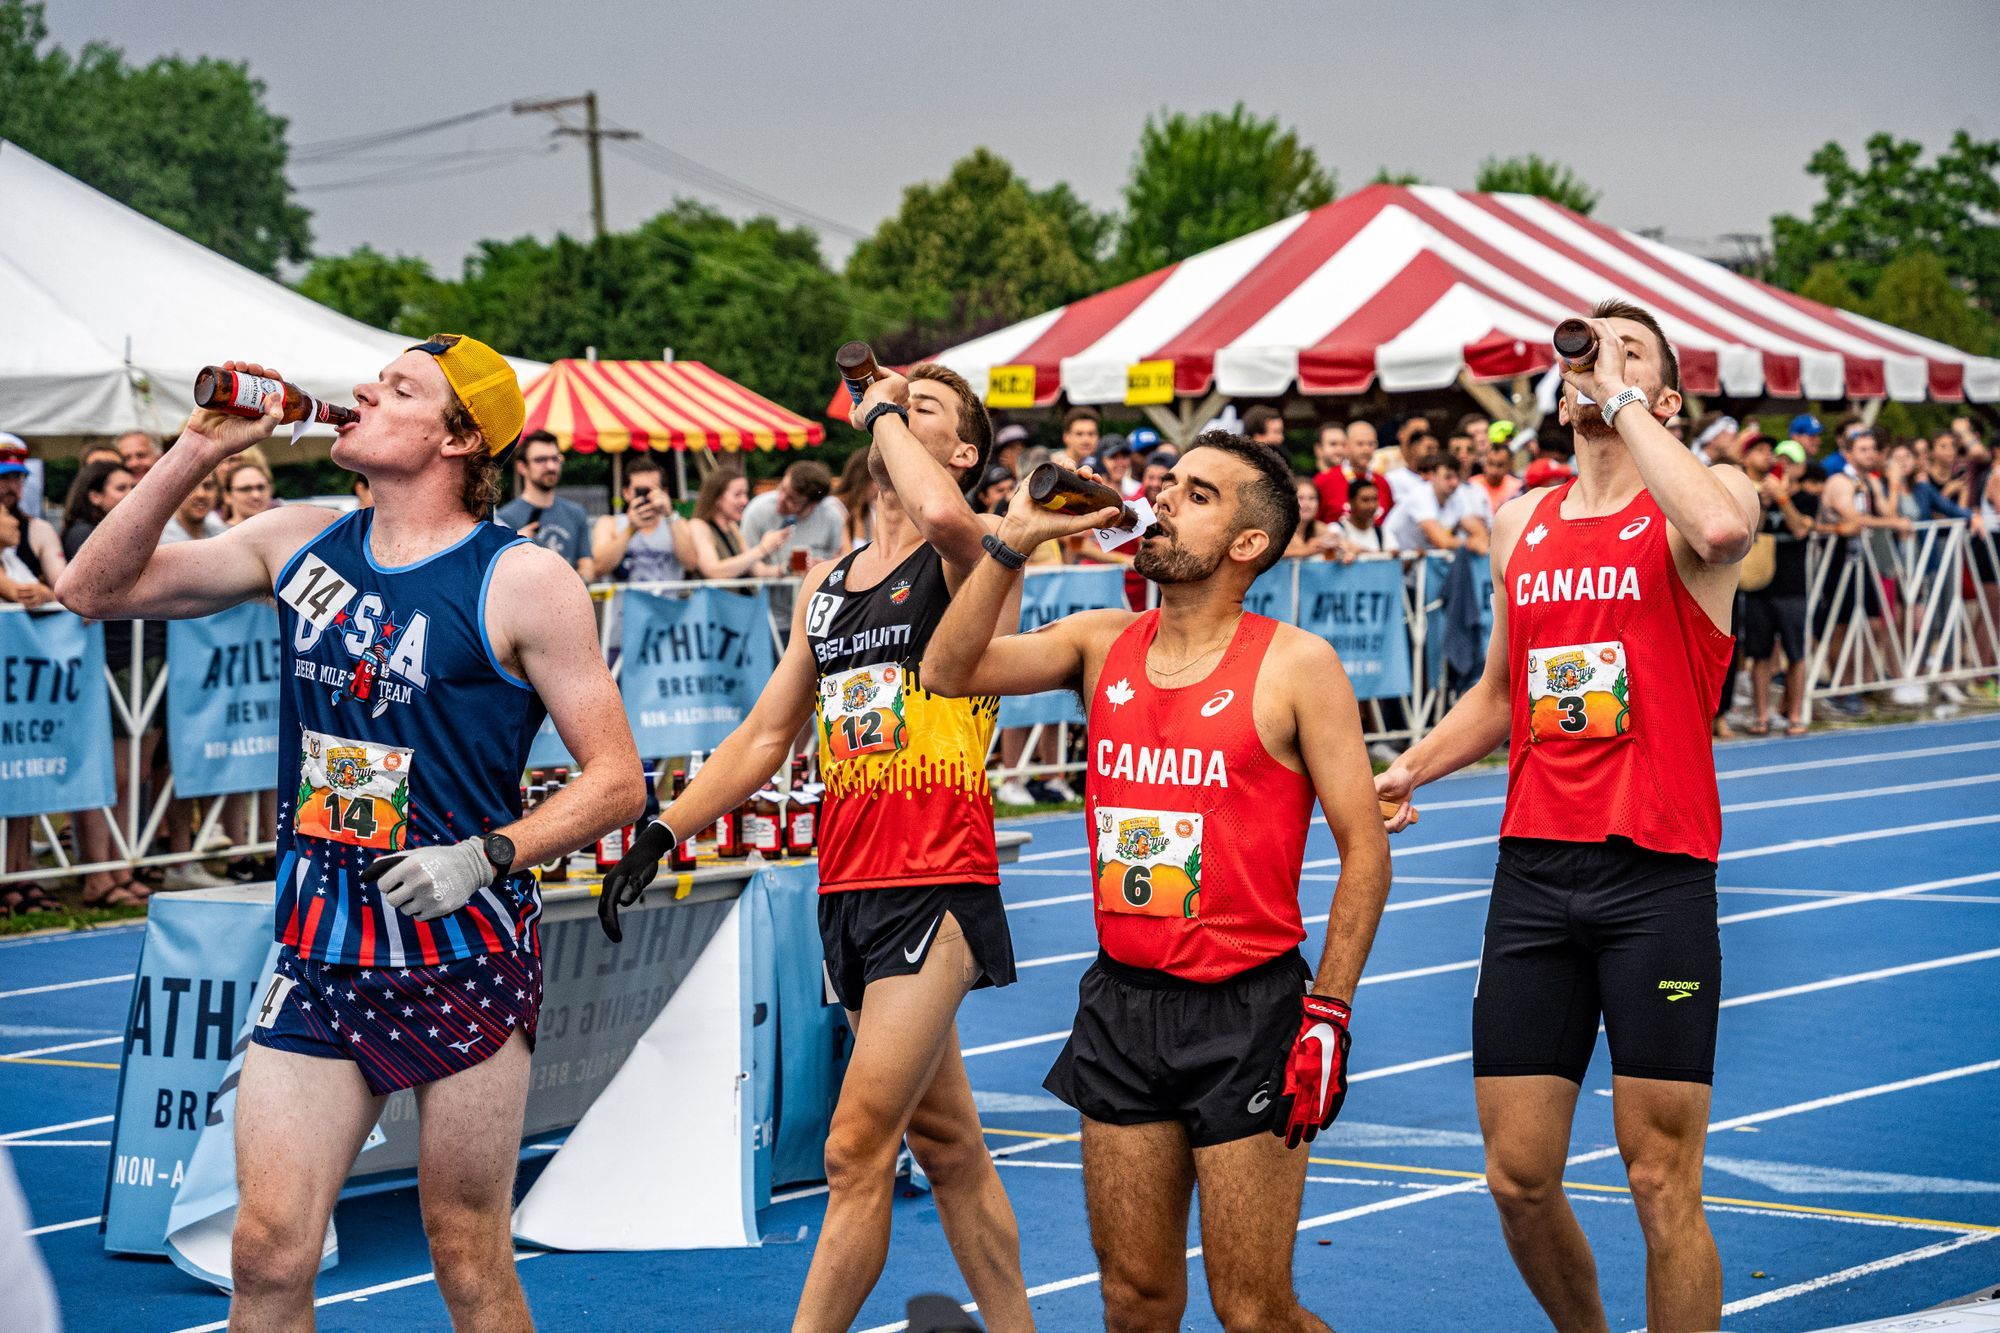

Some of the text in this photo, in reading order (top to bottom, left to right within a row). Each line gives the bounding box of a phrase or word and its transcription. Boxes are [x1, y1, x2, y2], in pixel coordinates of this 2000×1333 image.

[293, 565, 345, 620] 14
[1516, 566, 1642, 607] CANADA
[814, 624, 913, 664] BELGIUM
[294, 658, 413, 705] BEER MILE TEAM
[841, 709, 884, 752] 12
[1557, 695, 1588, 733] 3
[1096, 739, 1229, 788] CANADA
[324, 791, 378, 839] 14
[1122, 865, 1153, 907] 6
[1658, 980, 1700, 990] BROOKS
